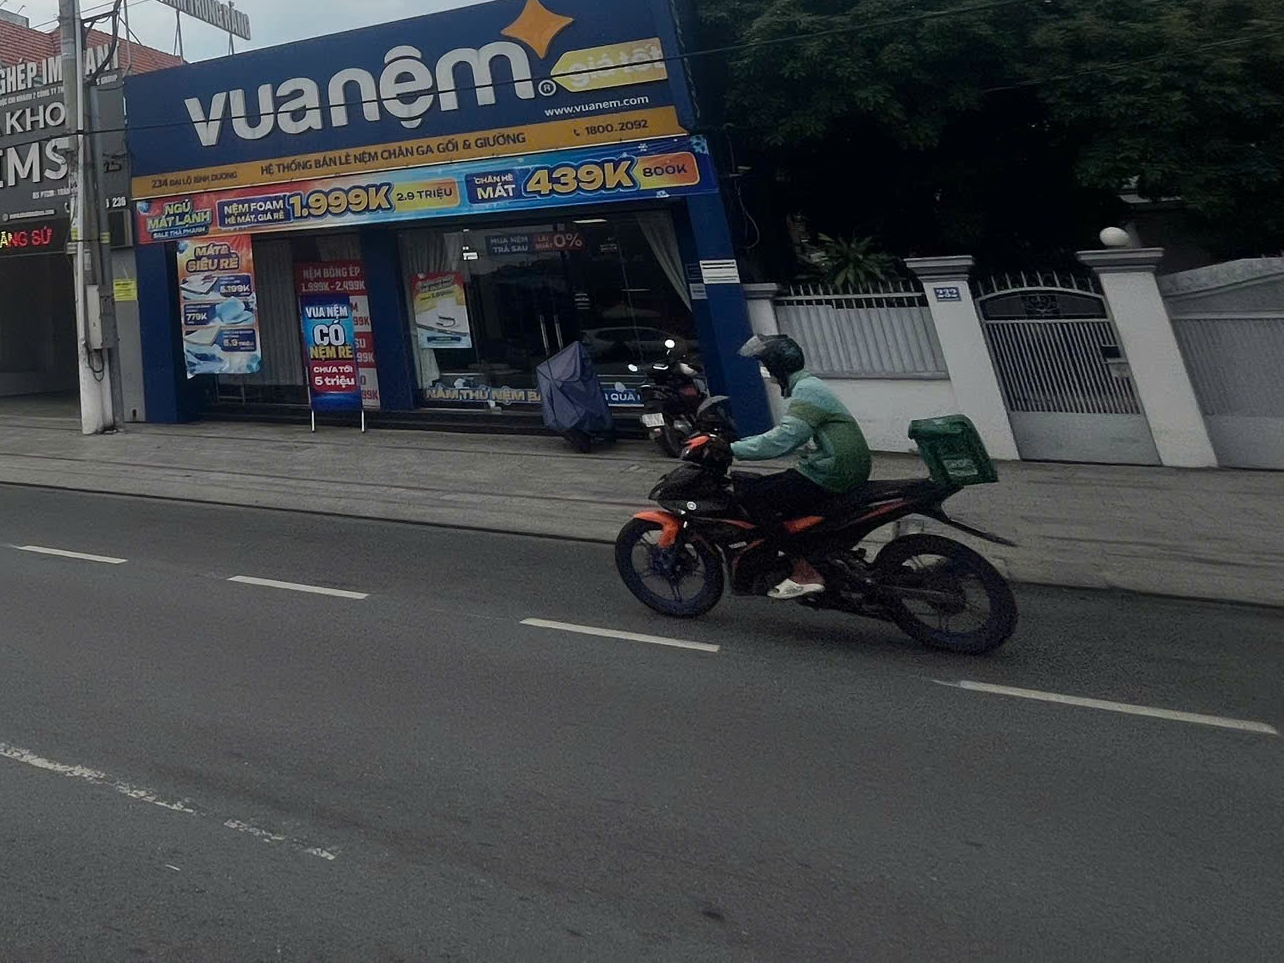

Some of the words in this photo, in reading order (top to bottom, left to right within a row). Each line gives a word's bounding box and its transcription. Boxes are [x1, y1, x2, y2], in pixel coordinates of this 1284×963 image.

[42, 42, 120, 86] IMANT
[545, 95, 649, 117] www.vuanem.com
[5, 101, 66, 135] KHO
[585, 119, 648, 136] 1800.2092
[261, 162, 274, 175] HỆ
[276, 157, 313, 174] THỐNG
[314, 153, 337, 169] BÁN
[339, 152, 352, 166] LẺ
[416, 143, 434, 156] GA
[437, 139, 459, 154] GỐI
[463, 138, 472, 149] &
[151, 178, 168, 188] 234
[526, 161, 634, 194] 439K
[642, 164, 687, 178] 800K
[290, 184, 392, 218] 1.999K
[396, 191, 415, 202] 2.9
[417, 187, 453, 200] TRIỆU
[476, 184, 516, 200] MÁT
[224, 203, 249, 216] NỆM
[250, 199, 283, 211] FOAM
[553, 232, 583, 248] 0%
[936, 288, 958, 298] 232
[305, 306, 326, 318] VUA
[326, 303, 348, 321] NỆM
[313, 320, 345, 346] CÓ
[315, 376, 322, 385] 5
[324, 375, 355, 388] triệu
